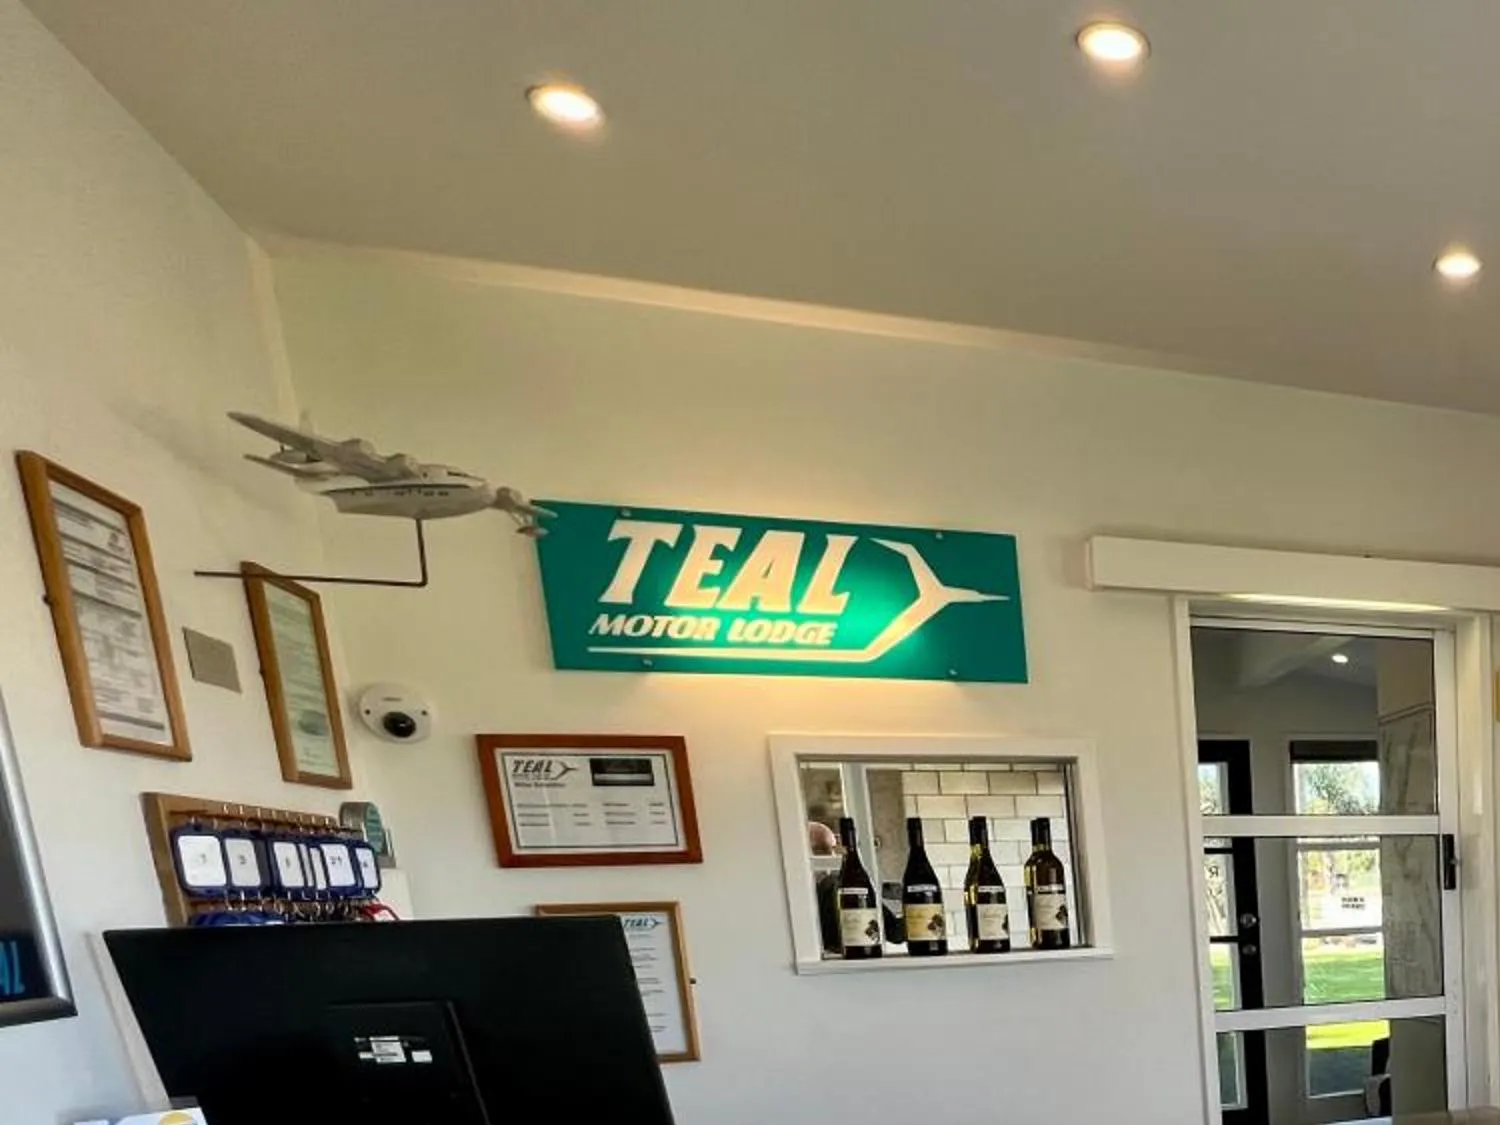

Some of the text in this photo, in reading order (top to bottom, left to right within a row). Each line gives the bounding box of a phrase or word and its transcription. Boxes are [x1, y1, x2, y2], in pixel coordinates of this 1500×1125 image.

[598, 518, 859, 616] TEAL
[588, 613, 838, 645] MOTOR LODGE
[511, 759, 554, 774] TEAL
